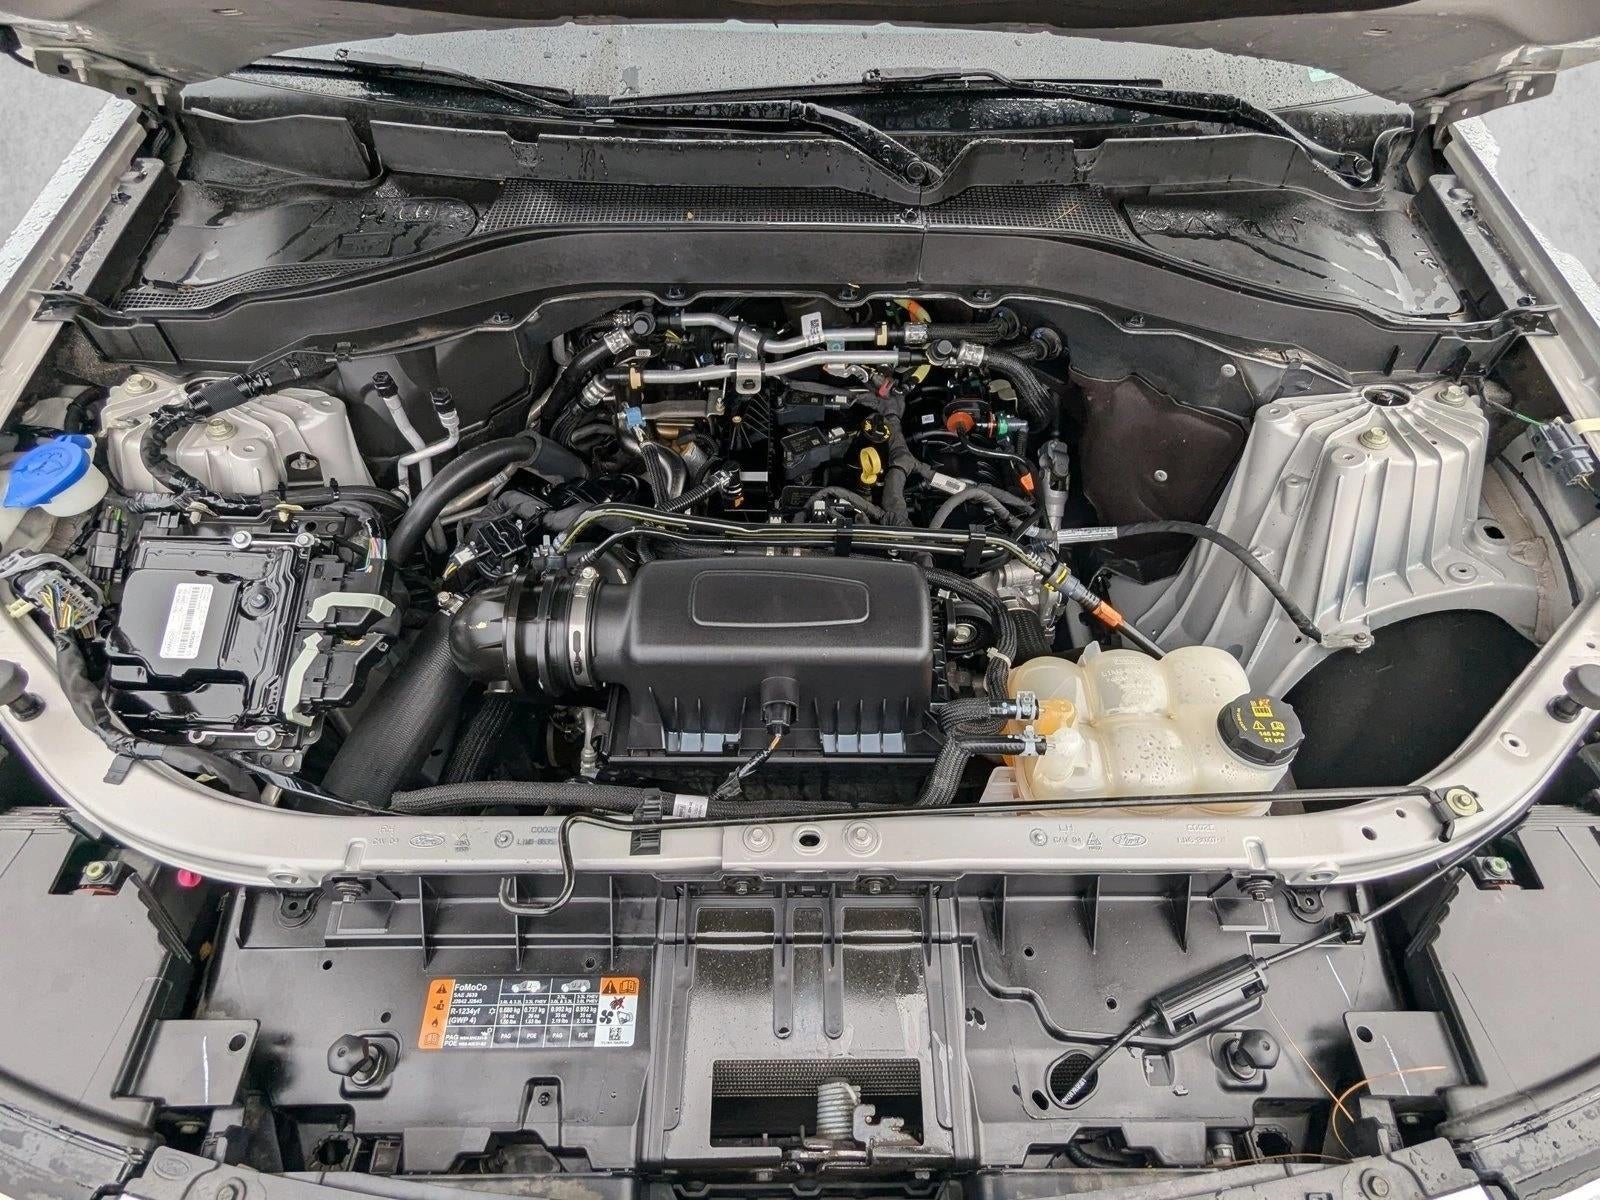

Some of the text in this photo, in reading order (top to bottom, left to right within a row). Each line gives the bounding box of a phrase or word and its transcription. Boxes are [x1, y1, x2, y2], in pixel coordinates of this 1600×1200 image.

[454, 983, 488, 991] FoMoCo
[450, 1007, 481, 1016] R-1234yf
[513, 1006, 521, 1014] kg
[538, 1006, 546, 1014] kg
[565, 1006, 573, 1014] kg
[590, 1006, 597, 1014] kg
[448, 1016, 477, 1024] (GWP 4)
